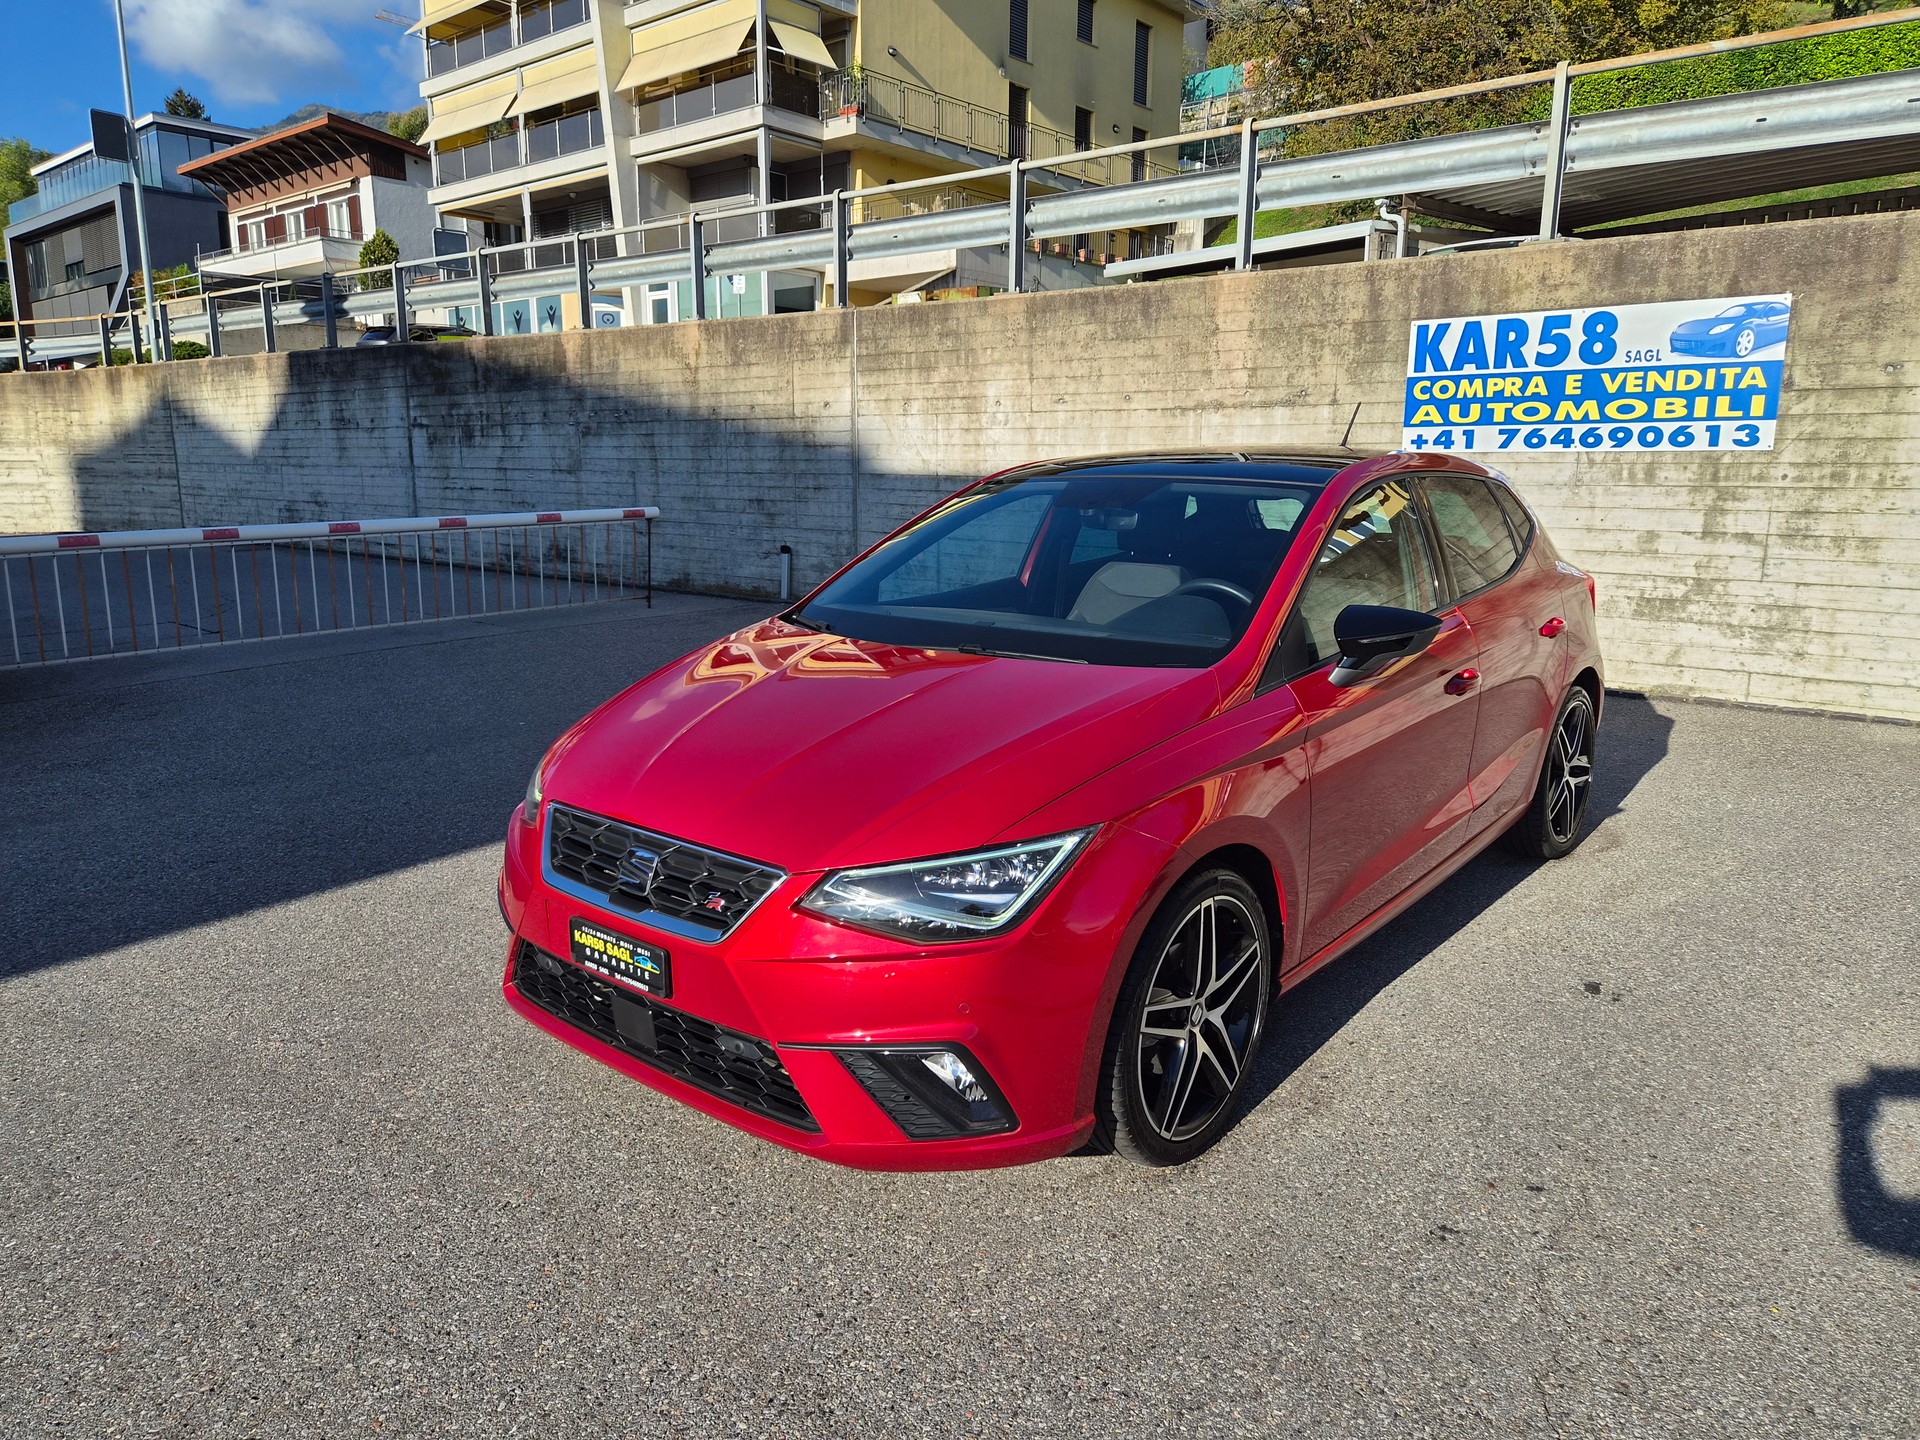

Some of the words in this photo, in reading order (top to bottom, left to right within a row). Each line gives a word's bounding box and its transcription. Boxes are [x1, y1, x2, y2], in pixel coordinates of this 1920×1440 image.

[1413, 310, 1619, 374] KAR58
[1624, 348, 1663, 365] SAGL
[1412, 374, 1549, 401] COMPRA
[1564, 373, 1583, 396] E
[1602, 365, 1768, 394] VENDITA
[1409, 394, 1767, 425] AUTOMOBILI
[1410, 428, 1476, 451] +41
[1497, 423, 1761, 450] 764690613
[574, 929, 605, 952] KAR58
[605, 942, 634, 964] SAGL
[585, 947, 650, 980] GARANTIE
